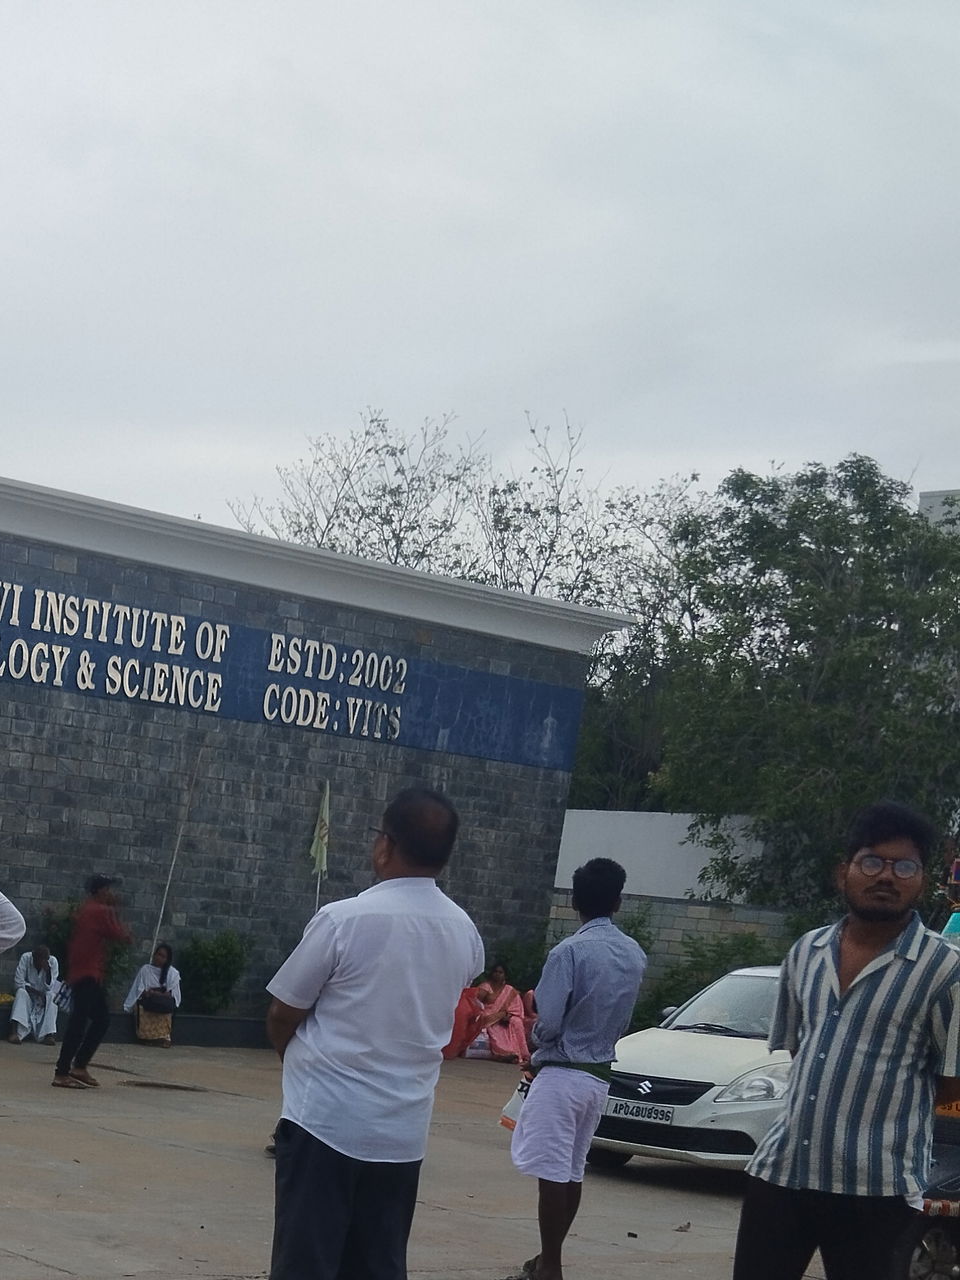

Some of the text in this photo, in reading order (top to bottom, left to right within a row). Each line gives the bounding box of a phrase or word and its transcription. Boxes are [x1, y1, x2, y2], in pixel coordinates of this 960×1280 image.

[31, 589, 186, 656] INSTITUTE
[195, 621, 230, 663] OF
[76, 650, 96, 690] &
[105, 655, 222, 712] SCIENCE
